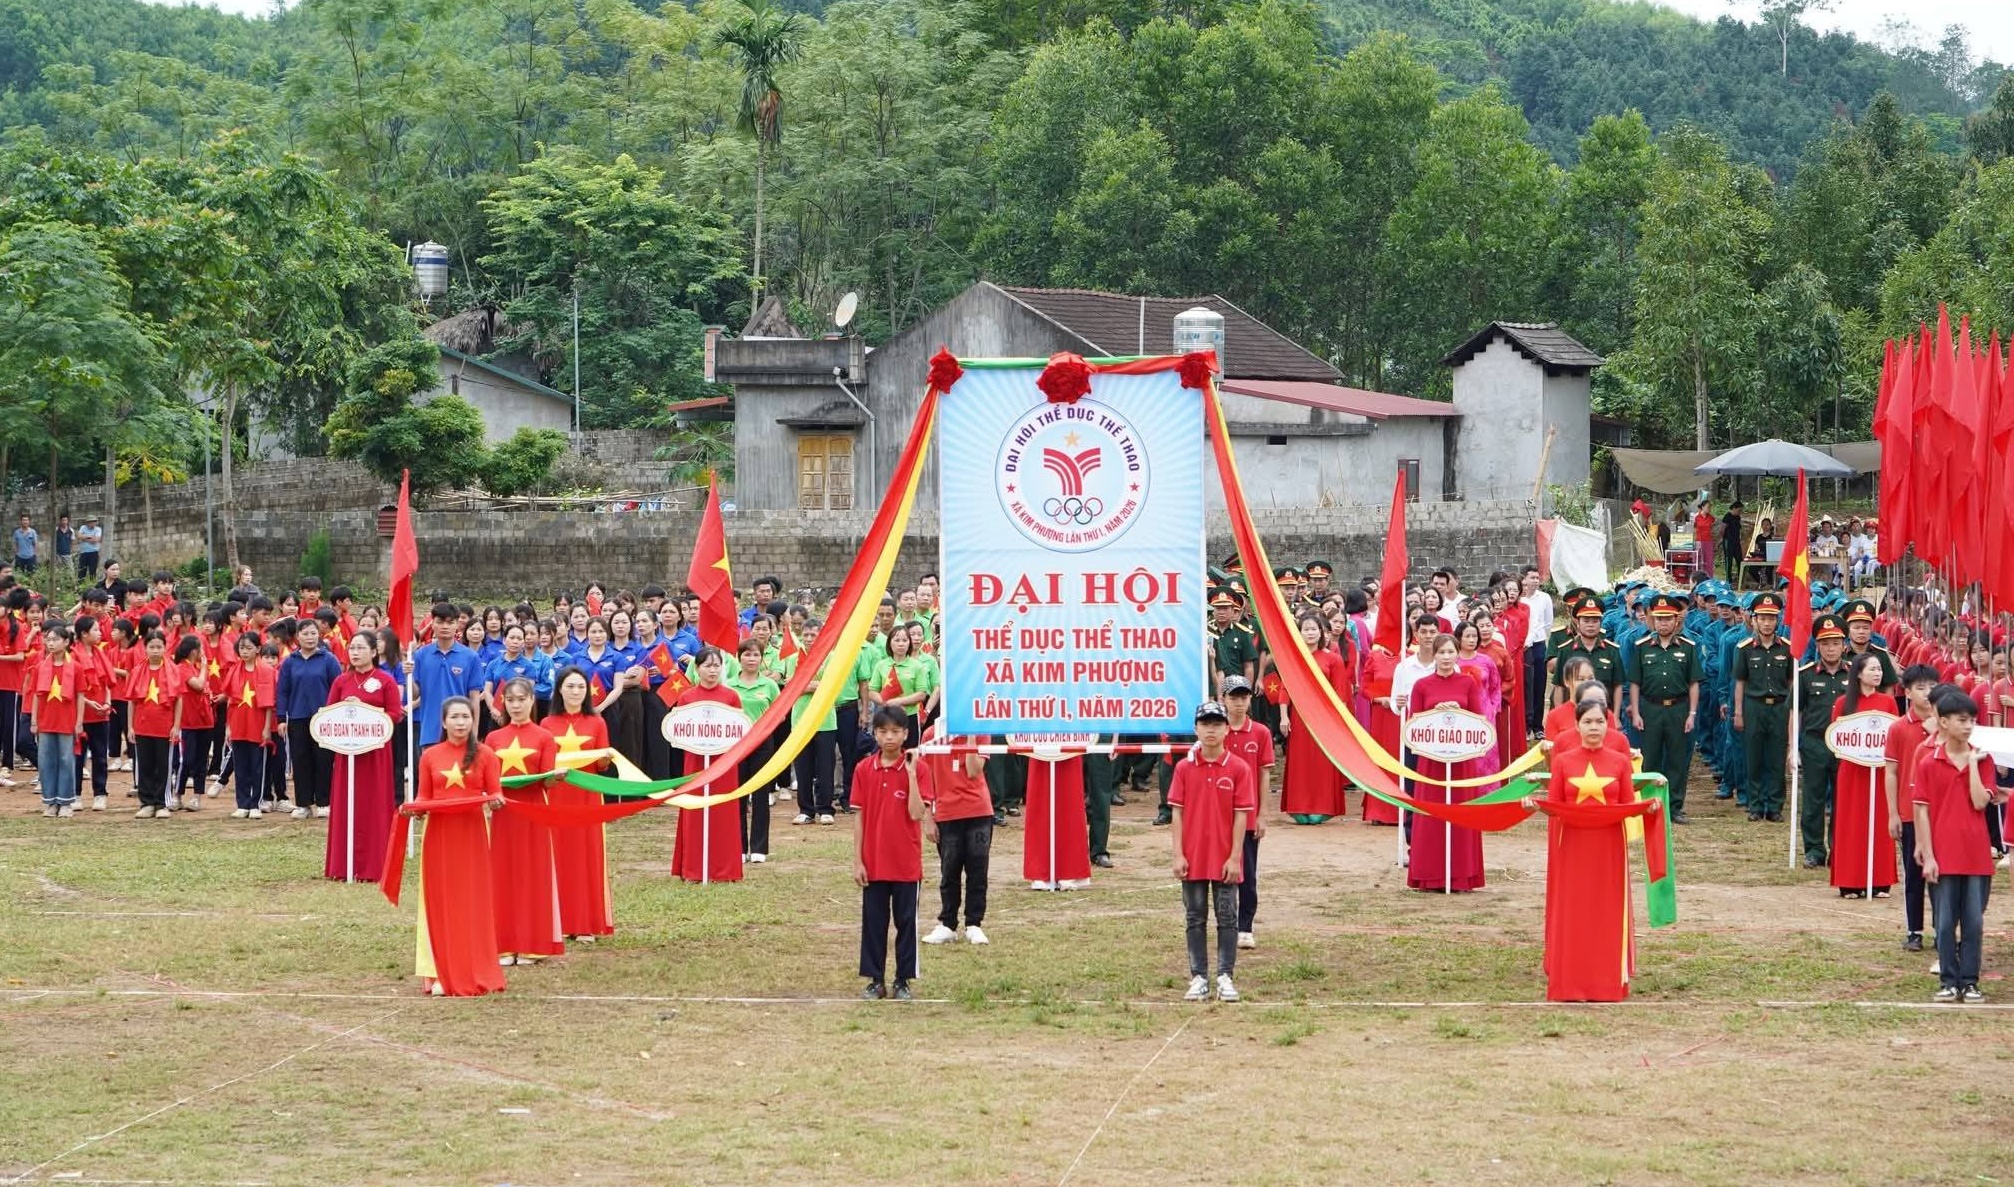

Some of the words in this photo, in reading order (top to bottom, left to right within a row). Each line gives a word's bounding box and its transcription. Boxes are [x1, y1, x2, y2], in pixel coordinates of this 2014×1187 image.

[1015, 423, 1037, 446] HỘI
[1036, 404, 1062, 427] THỂ
[1067, 407, 1095, 422] DỤC
[1099, 415, 1127, 438] THỂ
[1119, 437, 1140, 472] THAO
[1018, 510, 1035, 527] KIM
[1119, 499, 1137, 519] 2026
[968, 572, 1064, 614] ĐẠI
[1081, 567, 1182, 613] HỘI
[972, 620, 1014, 650] THỂ
[1020, 628, 1065, 655] DỤC
[1072, 619, 1114, 650] THỂ
[1120, 628, 1176, 649] THAO
[985, 658, 1015, 683] XÃ
[1022, 661, 1065, 683] KIM
[1073, 659, 1165, 687] PHƯỢNG
[974, 693, 1012, 719] LẦN
[1018, 695, 1056, 718] THỨ
[1060, 699, 1072, 720] I,
[1078, 695, 1123, 718] NĂM
[1130, 699, 1177, 718] 2026
[351, 723, 370, 738] THANH
[673, 717, 695, 738] KHỐI
[698, 720, 722, 738] NÔNG
[725, 721, 743, 738] DÂN
[1411, 723, 1435, 743] KHỐI
[1438, 726, 1462, 744] GIÁO
[1465, 730, 1487, 749] DỤC
[1836, 726, 1861, 747] KHỐI
[1865, 730, 1887, 749] QUÂ
